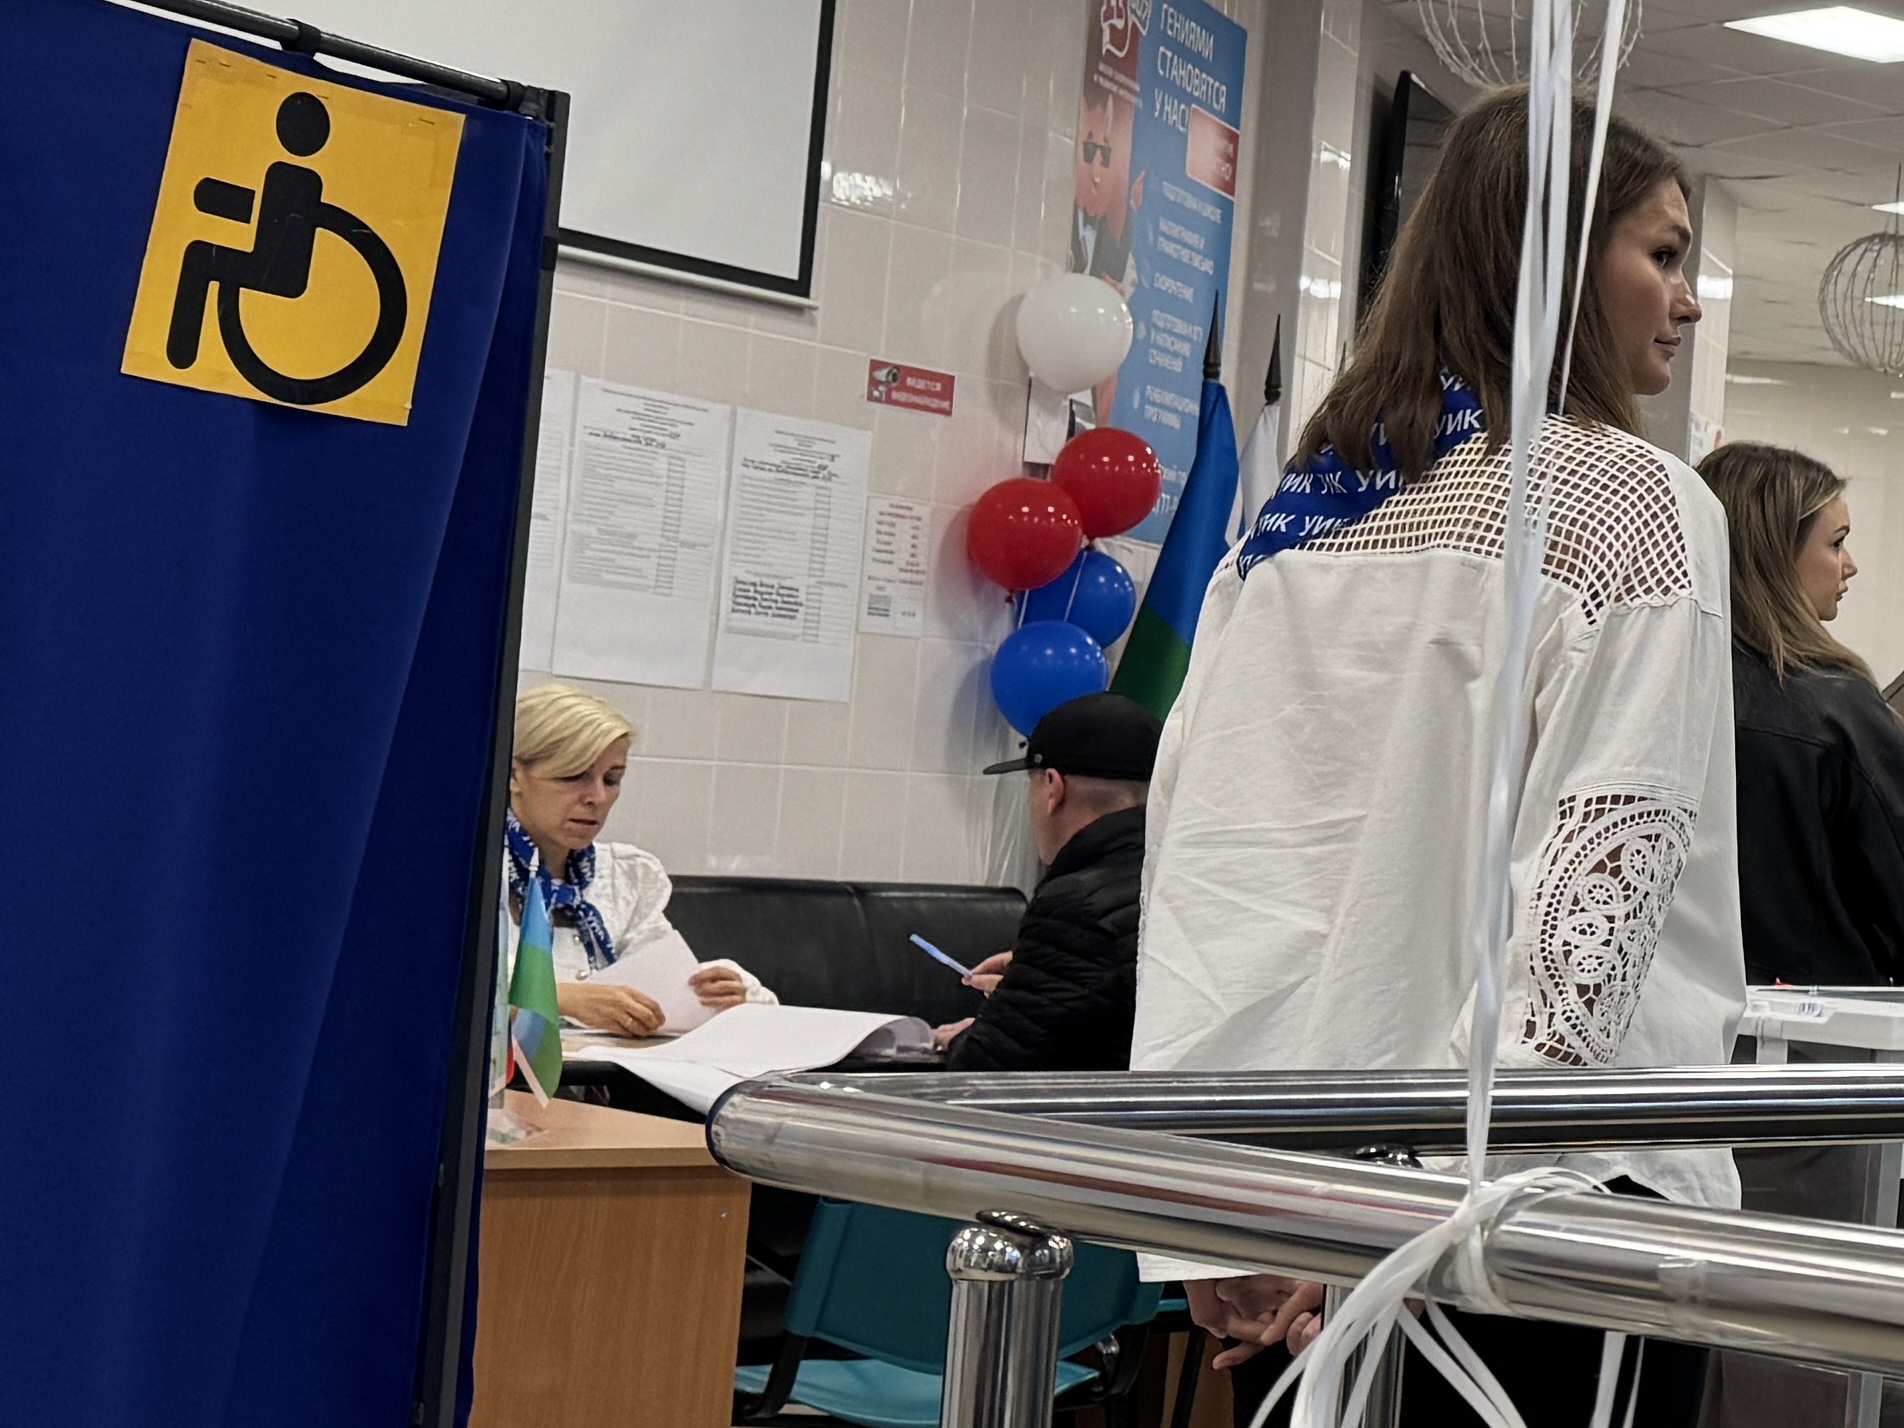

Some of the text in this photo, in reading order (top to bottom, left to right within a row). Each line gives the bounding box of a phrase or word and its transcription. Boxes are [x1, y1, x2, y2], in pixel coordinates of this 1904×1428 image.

[1160, 3, 1214, 62] ГЕНИЯМИ
[1154, 88, 1163, 117] У
[1157, 45, 1227, 113] СТАНОВЯТСЯ
